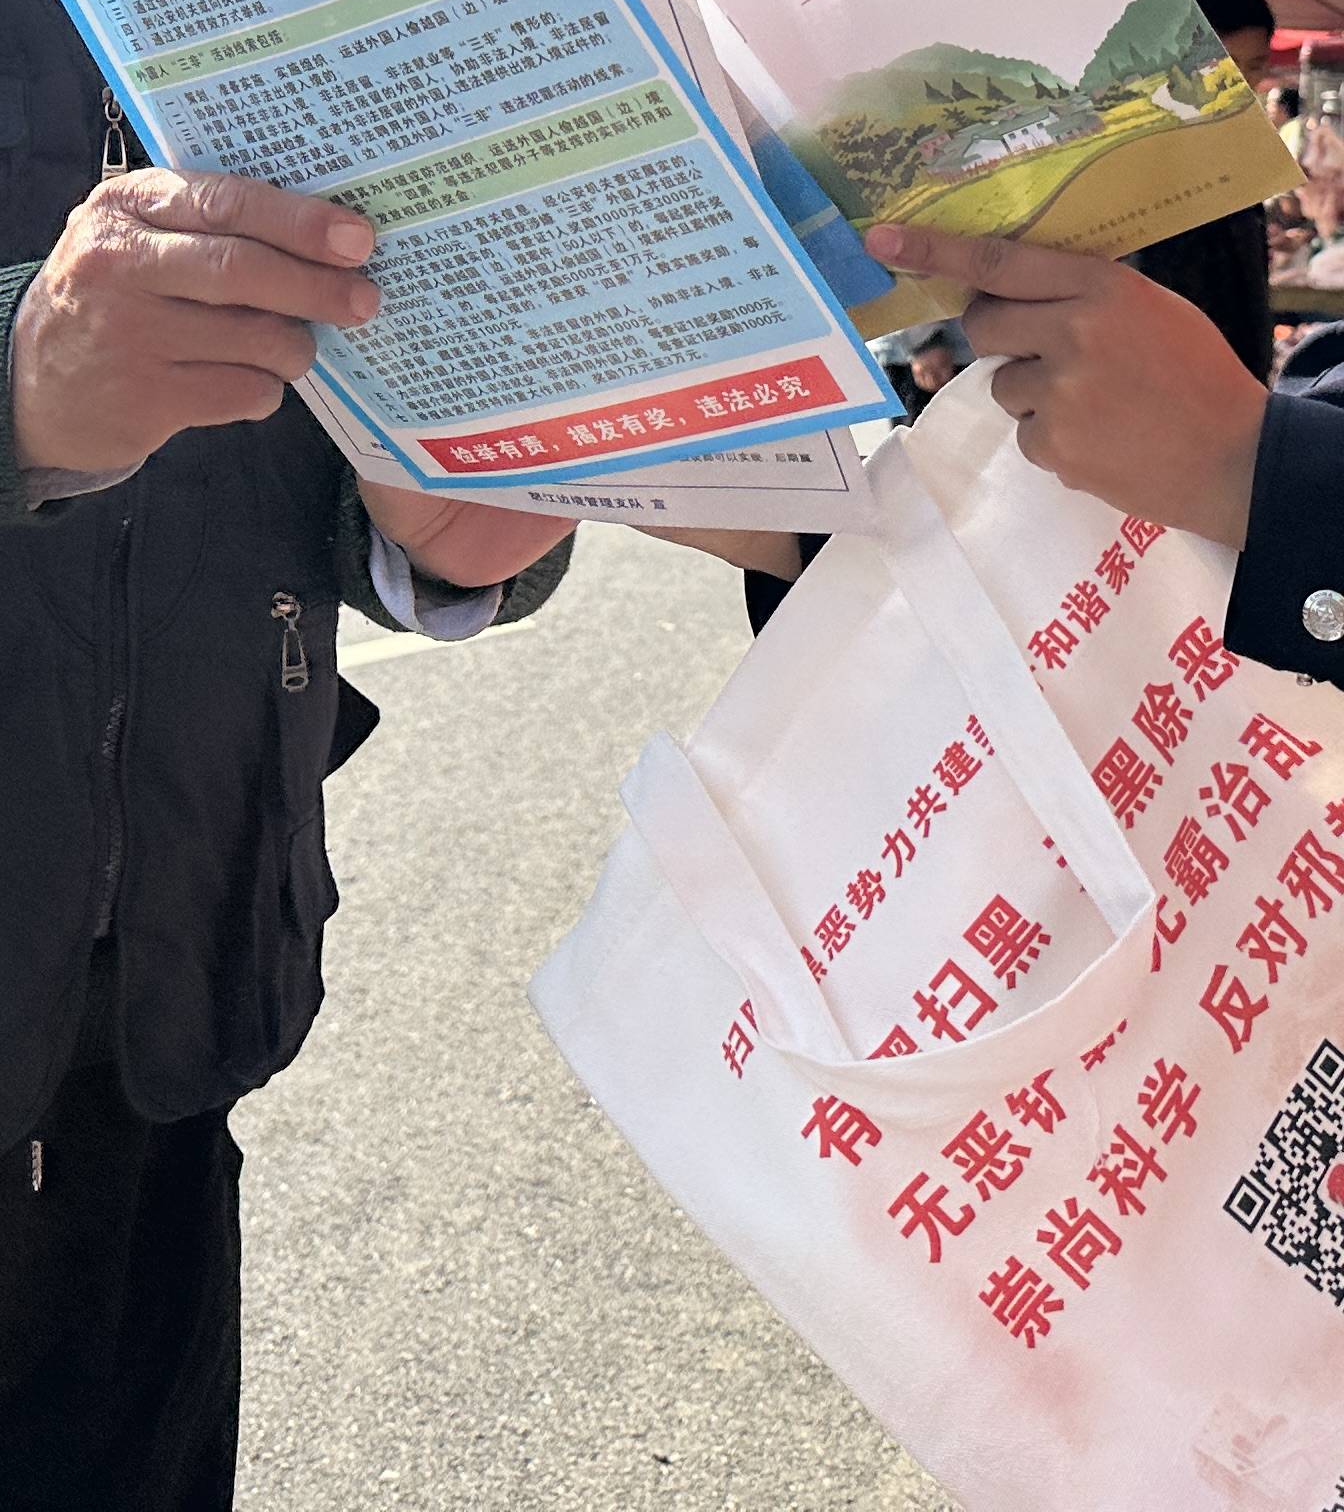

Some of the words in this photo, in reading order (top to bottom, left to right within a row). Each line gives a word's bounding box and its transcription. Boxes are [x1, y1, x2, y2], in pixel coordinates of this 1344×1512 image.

[447, 373, 813, 468] 检举有责，揭发有奖，违法必究
[978, 1058, 1201, 1348] 崇尚科学
